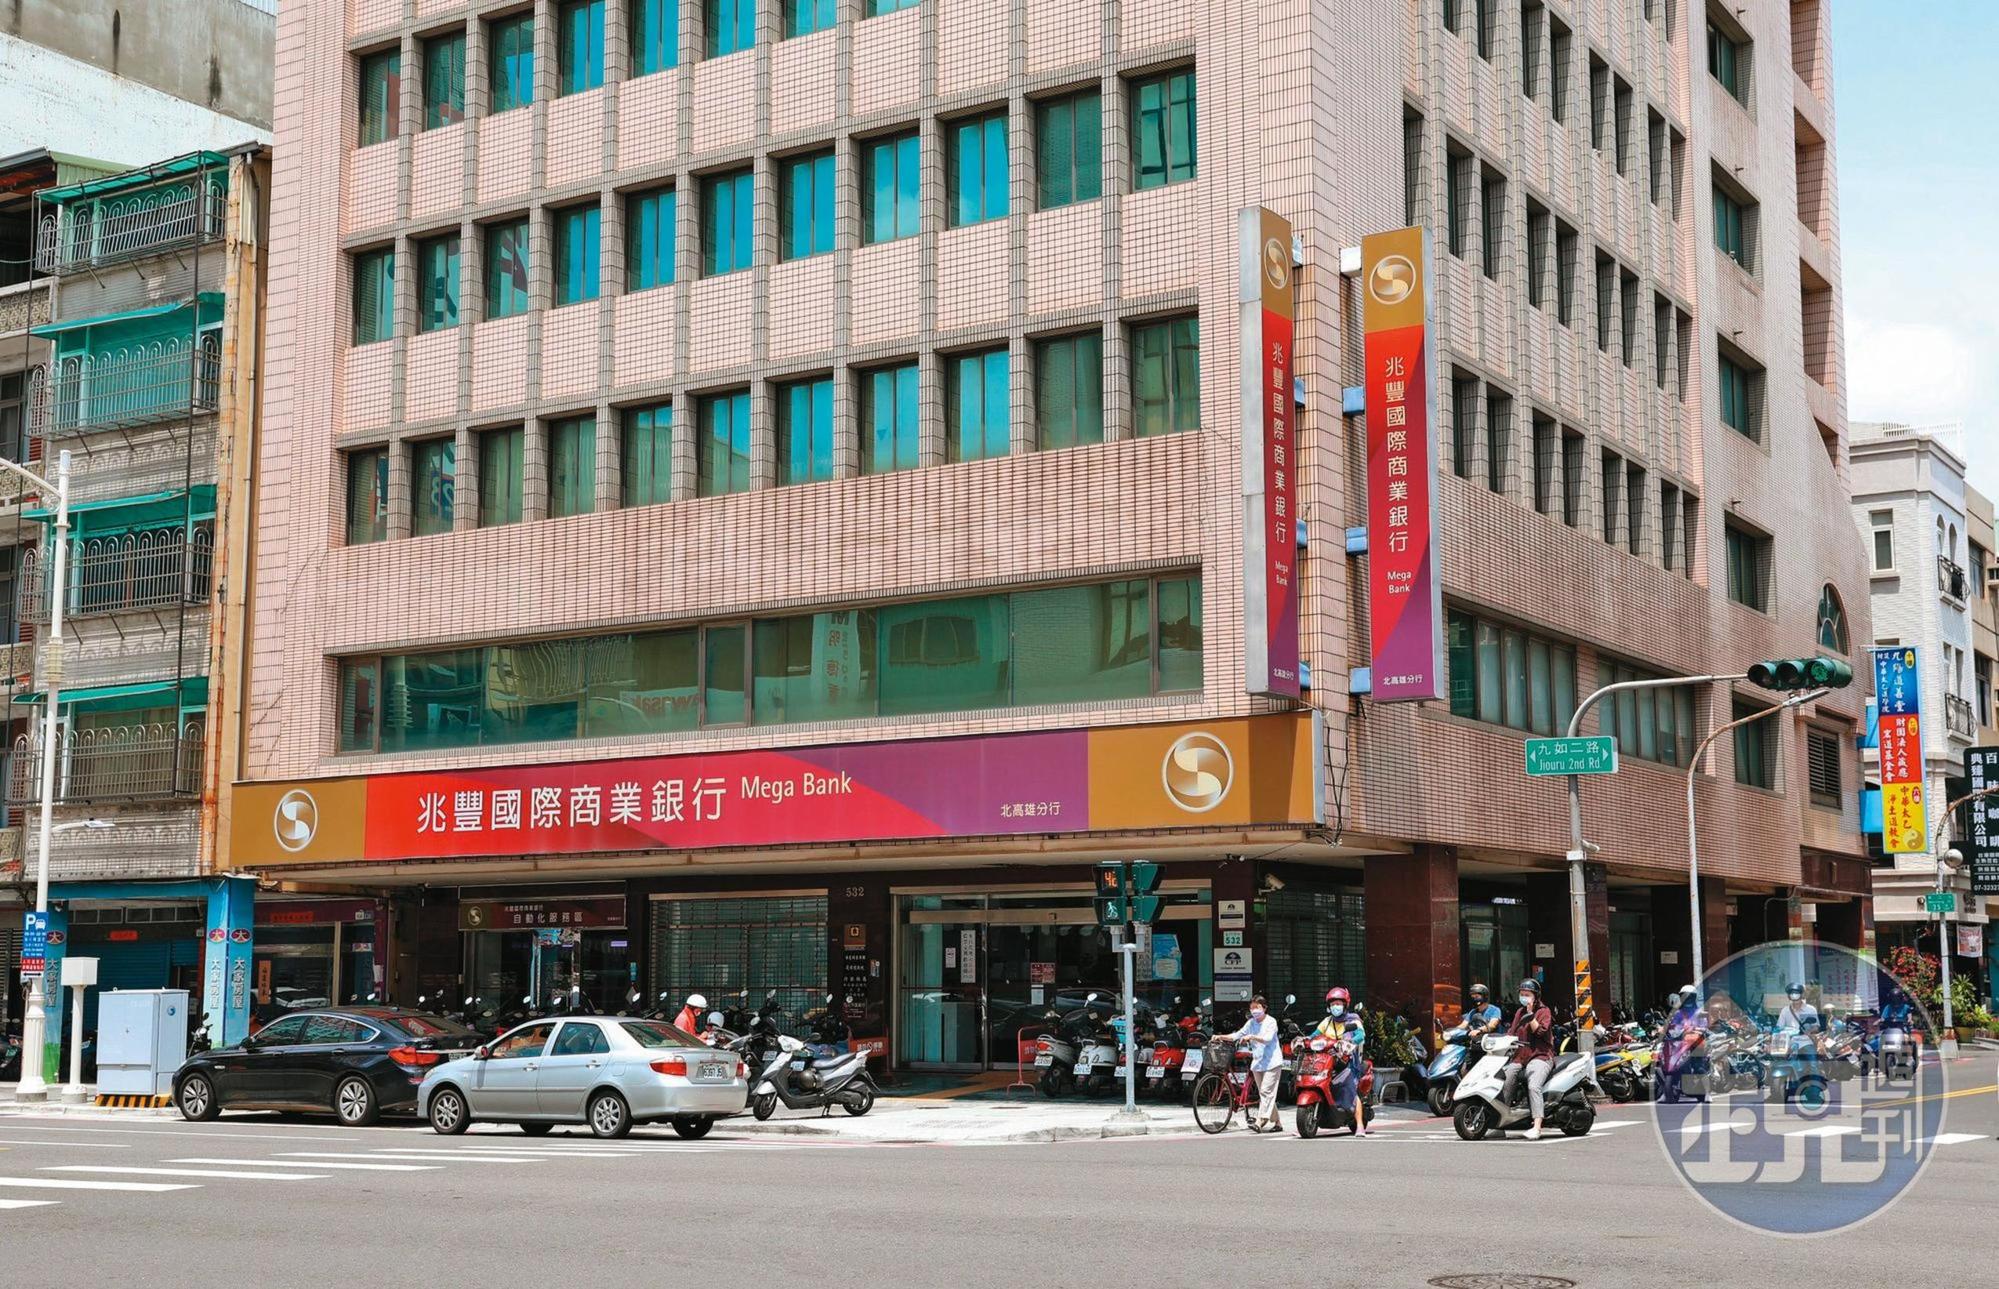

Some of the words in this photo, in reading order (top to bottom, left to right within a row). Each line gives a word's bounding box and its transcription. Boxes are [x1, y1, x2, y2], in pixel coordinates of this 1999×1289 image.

[1272, 342, 1286, 544] 兆豐國際商業銀行
[1385, 357, 1409, 552] 兆豐國際商業銀行
[1274, 560, 1288, 575] Mega
[1276, 574, 1288, 586] Bank
[1387, 571, 1412, 587] Mega
[1388, 584, 1411, 594] Bank
[1273, 667, 1294, 681] 北高雄分行
[1383, 673, 1424, 686] 北高雄分行
[1538, 741, 1600, 755] 九如二路
[1539, 759, 1565, 771] Jiouru
[1569, 758, 1585, 770] 2nd
[416, 776, 727, 834] 兆豐國際商業銀行
[741, 775, 795, 804] Mega
[803, 771, 853, 795] Bank
[1000, 801, 1061, 818] 北高雄分行
[846, 887, 865, 897] 532
[25, 913, 36, 931] P
[513, 912, 583, 925] 自動化服務區
[1225, 937, 1241, 945] 532
